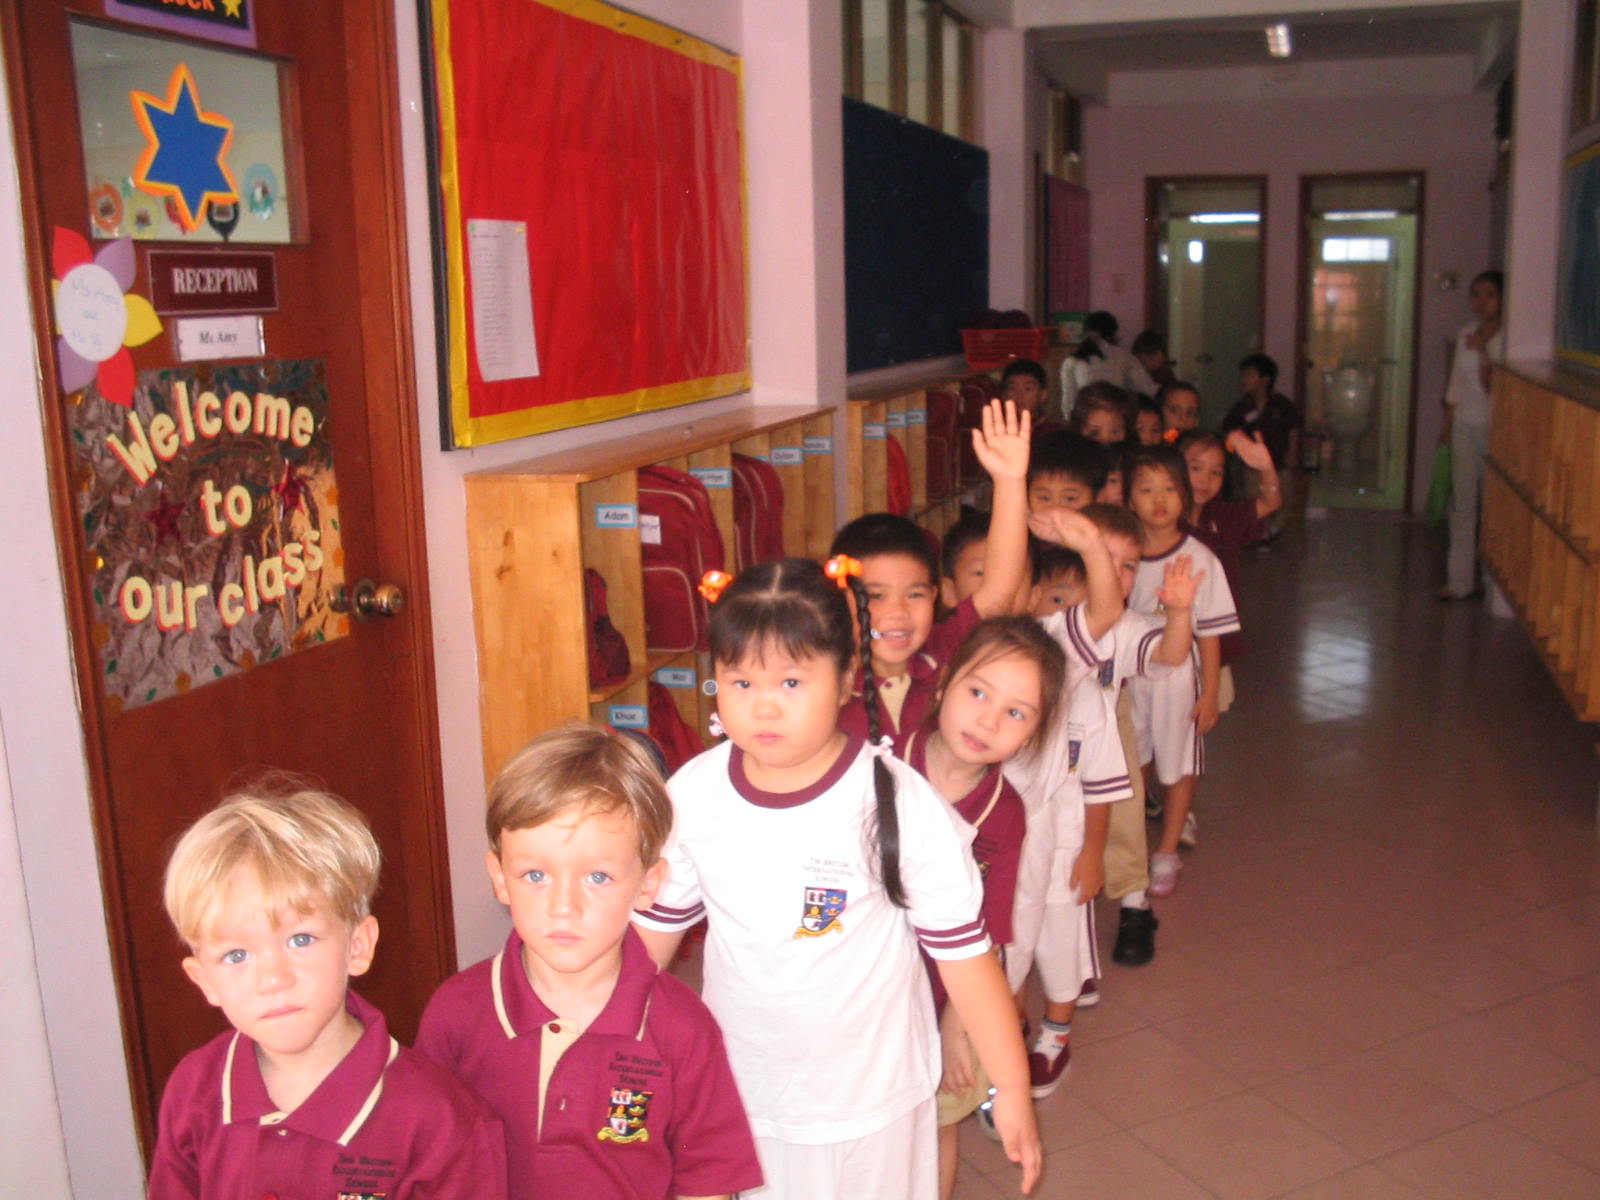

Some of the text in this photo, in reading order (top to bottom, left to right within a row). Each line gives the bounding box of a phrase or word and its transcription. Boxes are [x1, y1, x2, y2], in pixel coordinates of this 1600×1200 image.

[173, 267, 258, 293] RECEPTION
[106, 381, 315, 486] Welcome
[201, 480, 253, 537] to
[120, 530, 324, 632] our class
